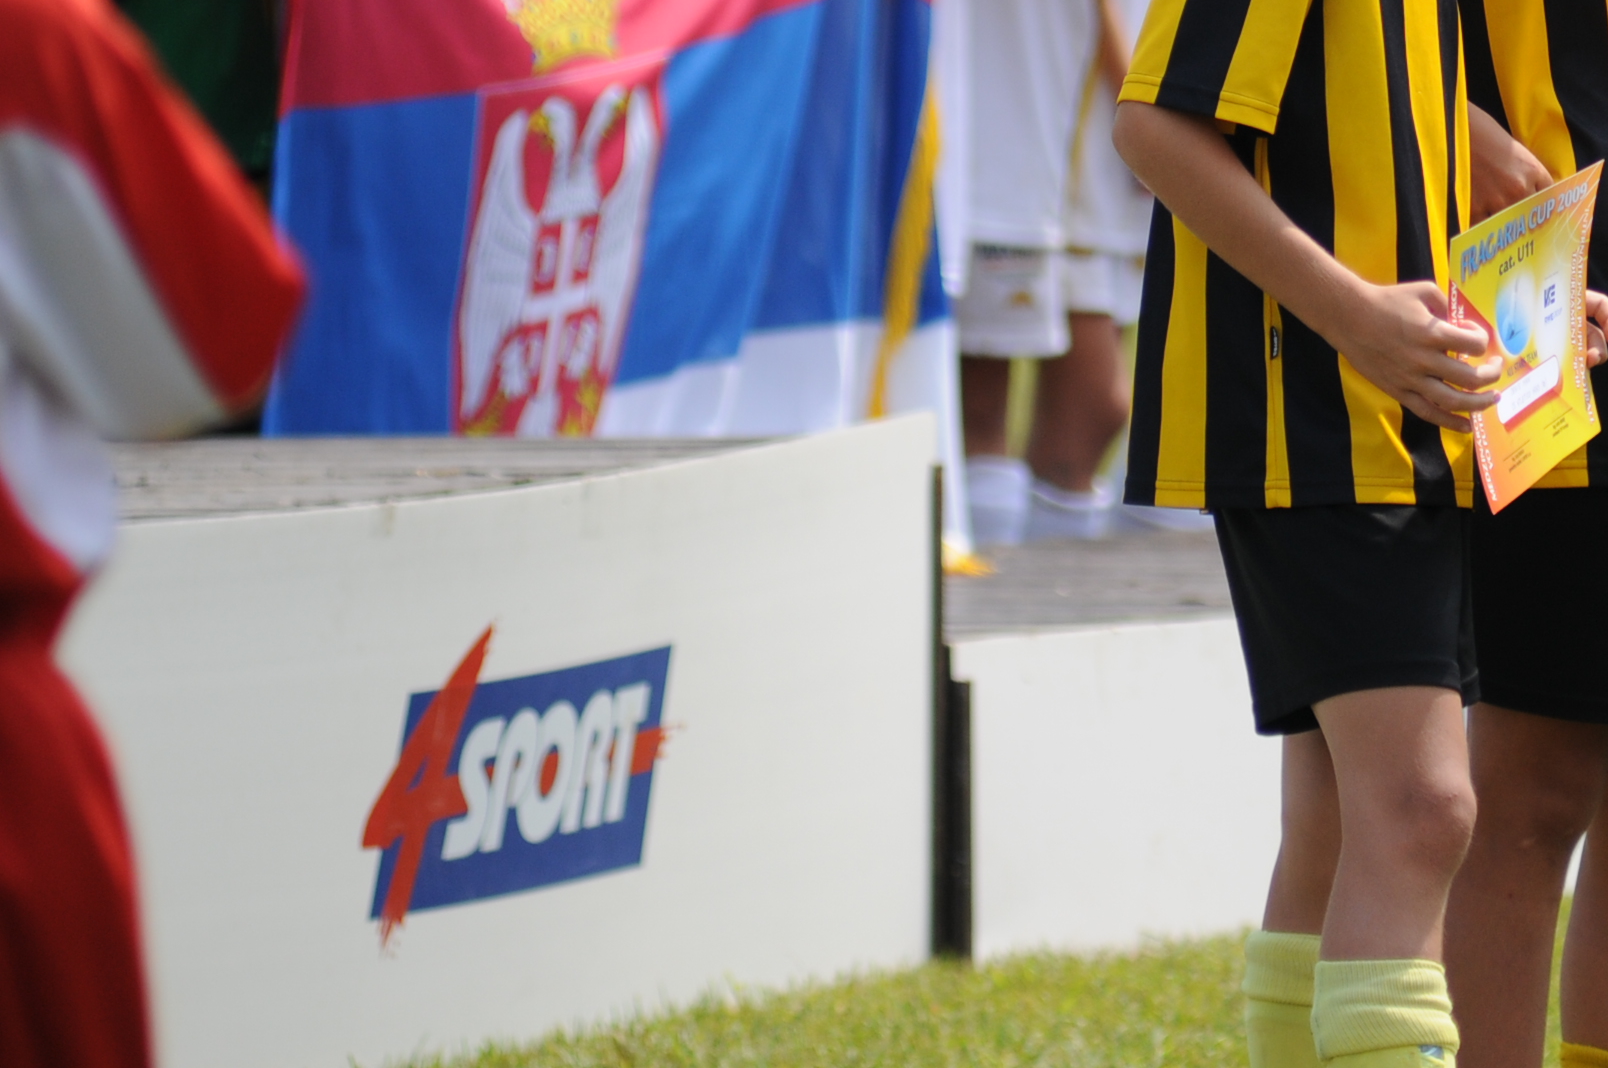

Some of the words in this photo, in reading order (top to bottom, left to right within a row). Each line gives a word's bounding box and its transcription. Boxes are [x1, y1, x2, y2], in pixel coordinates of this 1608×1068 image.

[1460, 215, 1526, 282] FRAGARIA
[1528, 198, 1556, 231] CUP
[1556, 181, 1589, 213] 2009
[1498, 254, 1516, 276] cat.
[1516, 239, 1535, 263] U11
